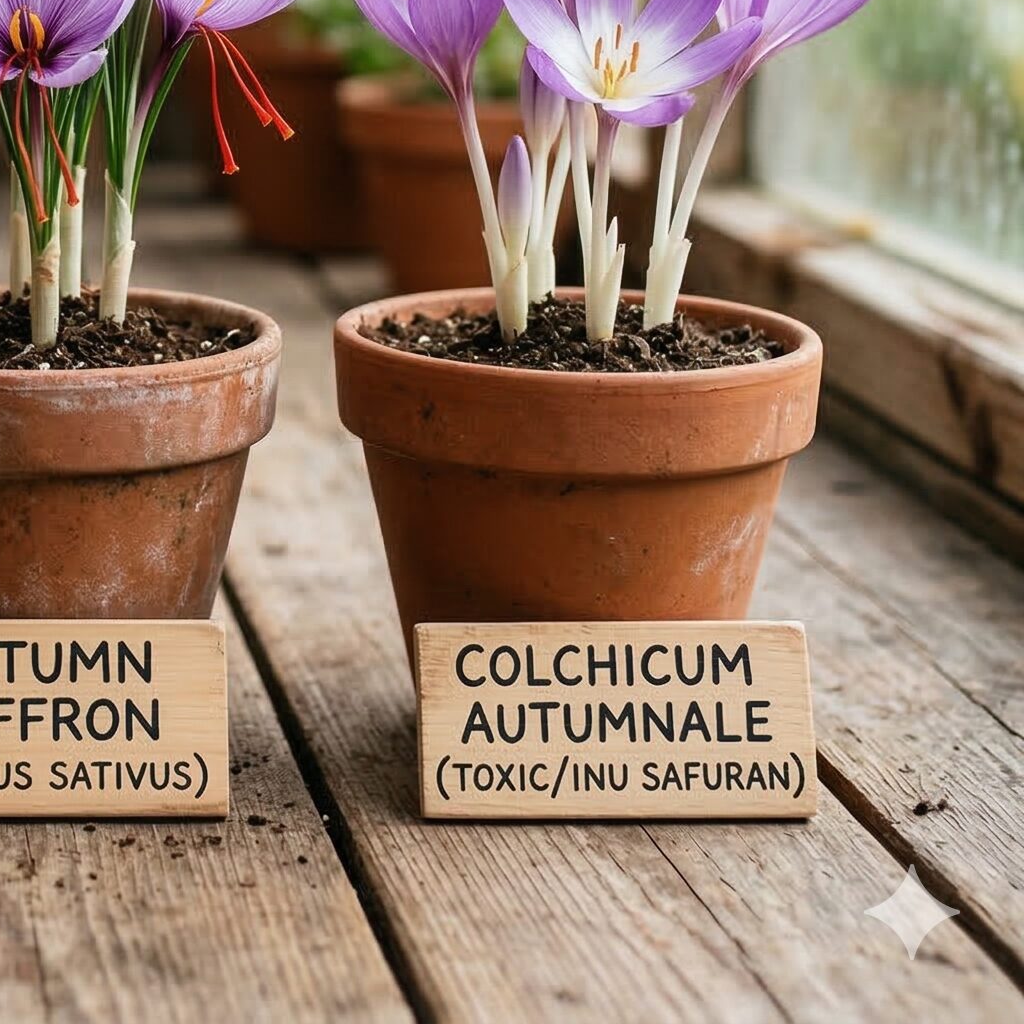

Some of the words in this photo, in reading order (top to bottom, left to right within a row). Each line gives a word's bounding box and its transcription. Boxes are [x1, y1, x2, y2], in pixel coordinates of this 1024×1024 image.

[455, 643, 753, 688] COLCHICUM
[461, 700, 773, 745] AUTUMNALE
[49, 752, 209, 799] SATIVUS)
[436, 755, 628, 801] (TOXIC/INU
[642, 752, 805, 799] SAFURAN)
